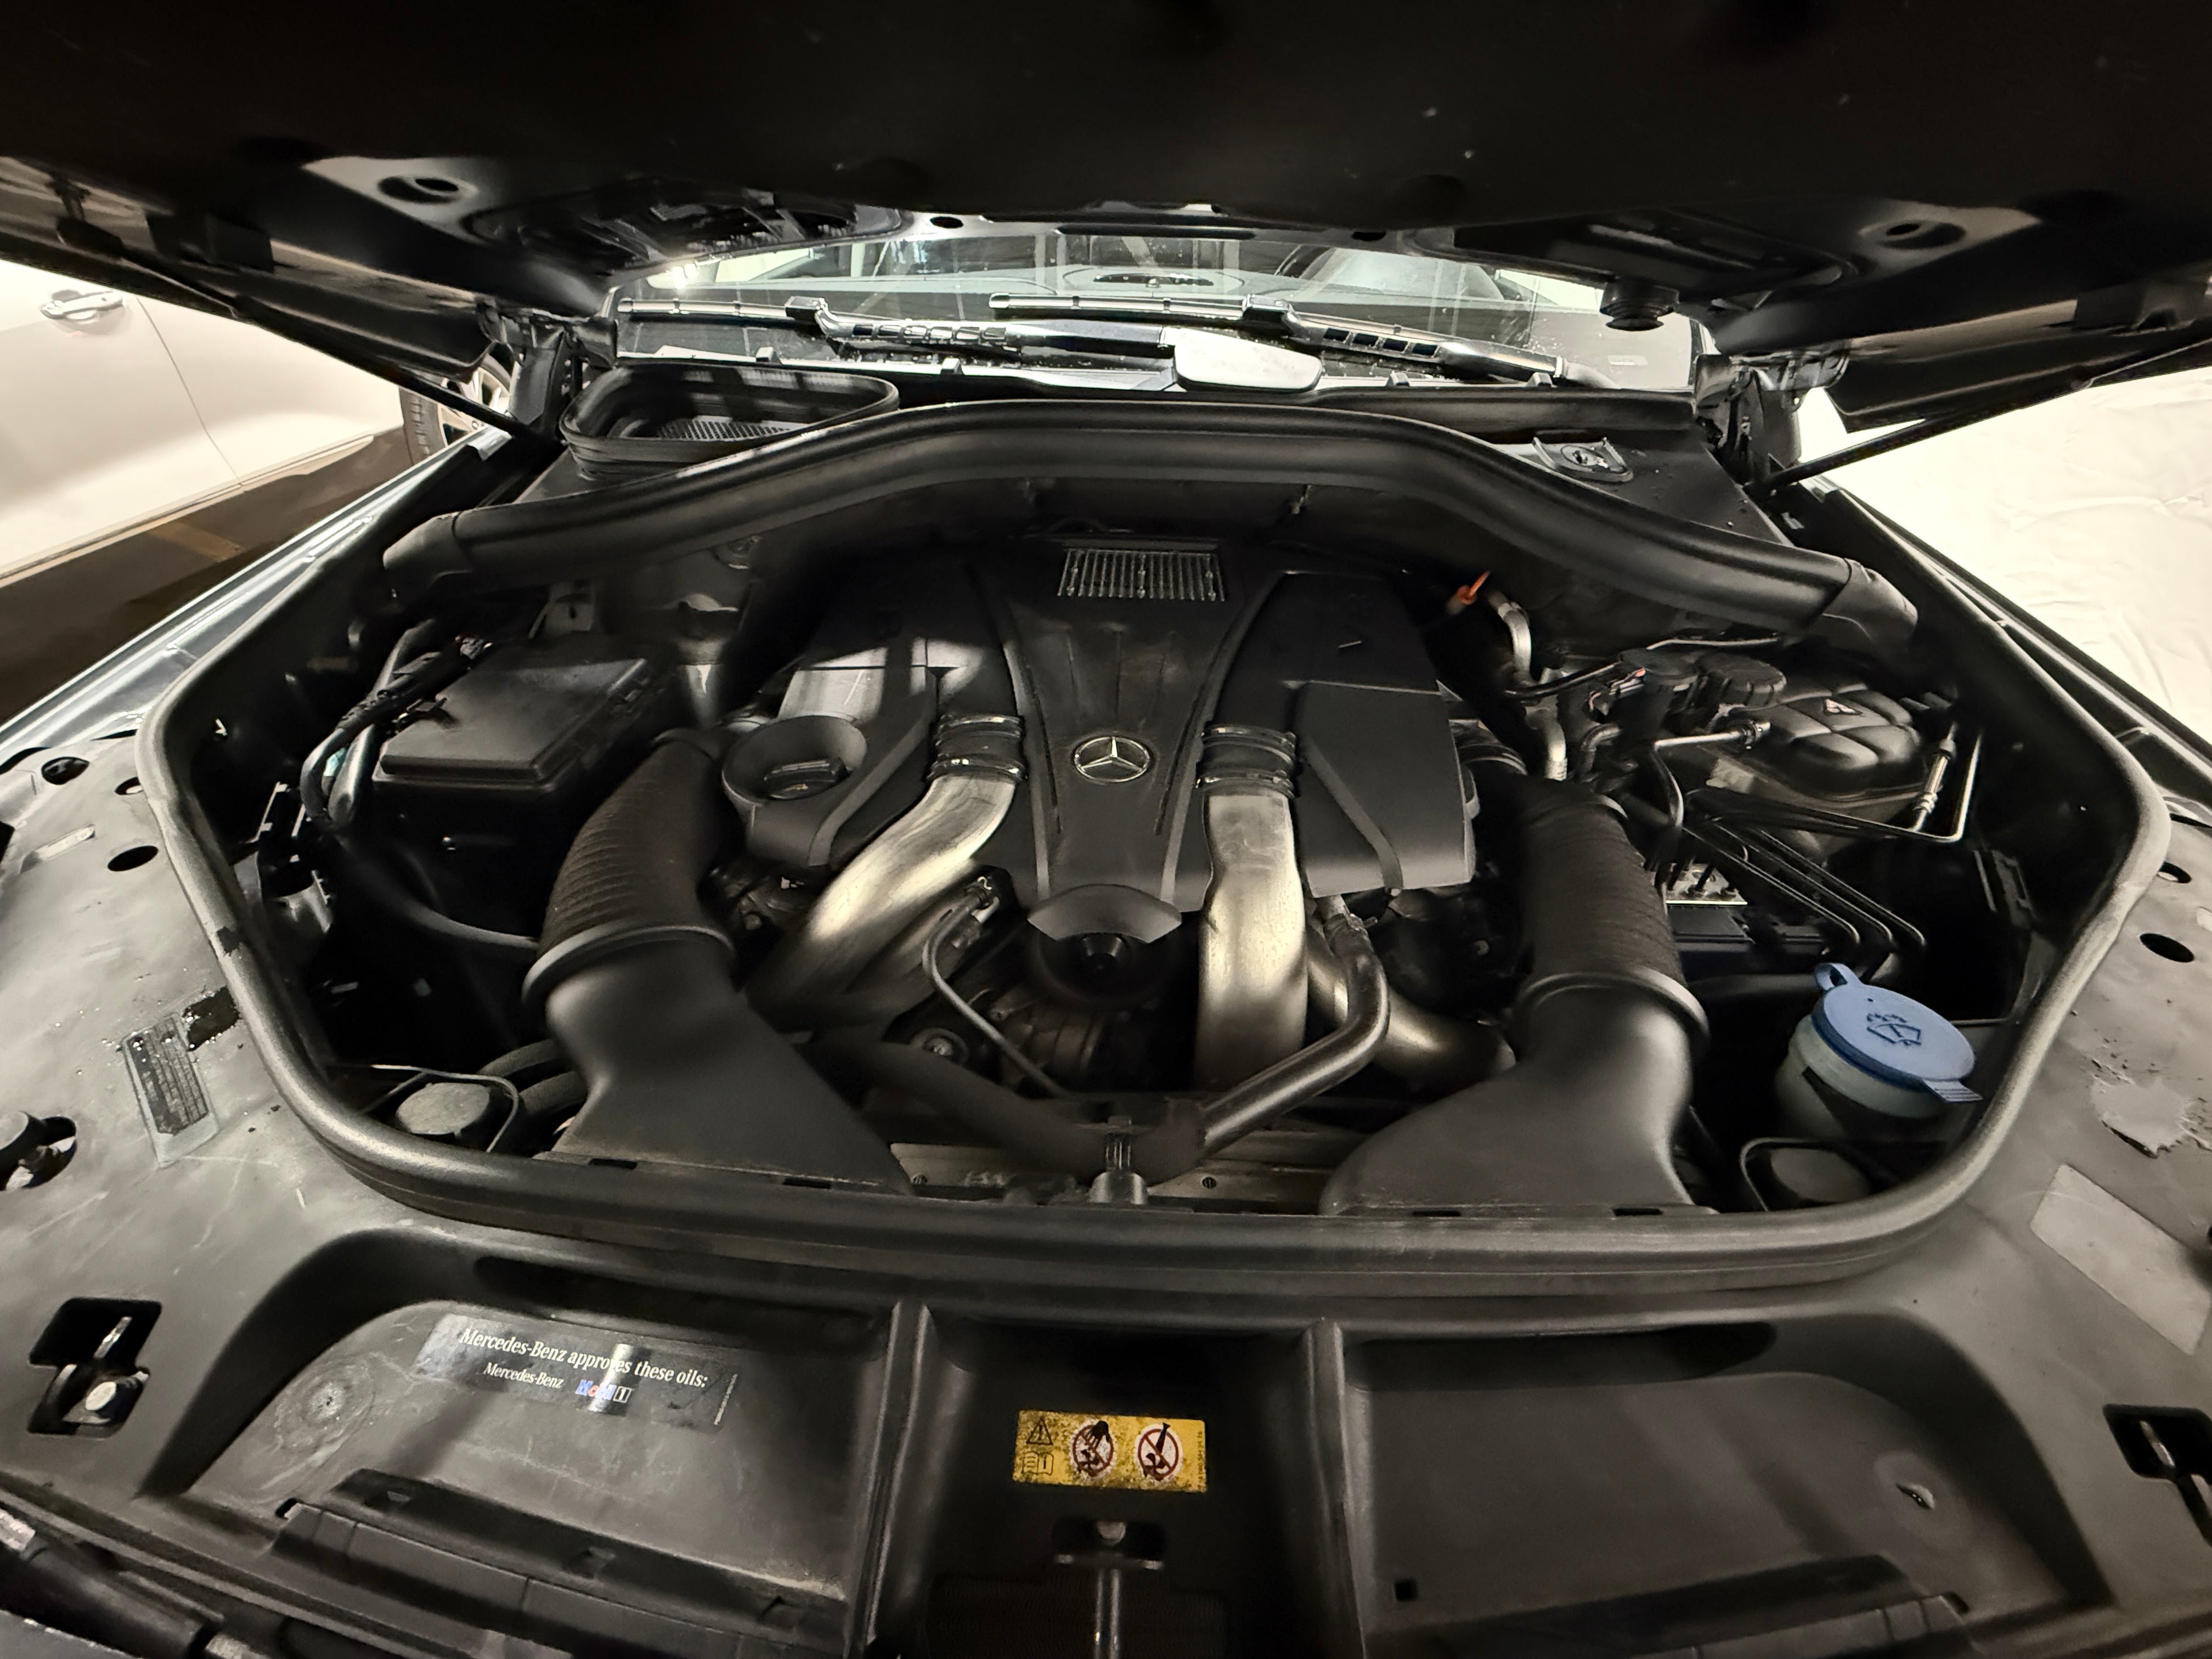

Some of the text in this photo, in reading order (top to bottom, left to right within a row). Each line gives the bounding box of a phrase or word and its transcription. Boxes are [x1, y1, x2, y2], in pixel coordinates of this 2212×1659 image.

[459, 1328, 708, 1388] Mercedes-Benz approves these oils:
[483, 1362, 565, 1389] Mercedes-Benz
